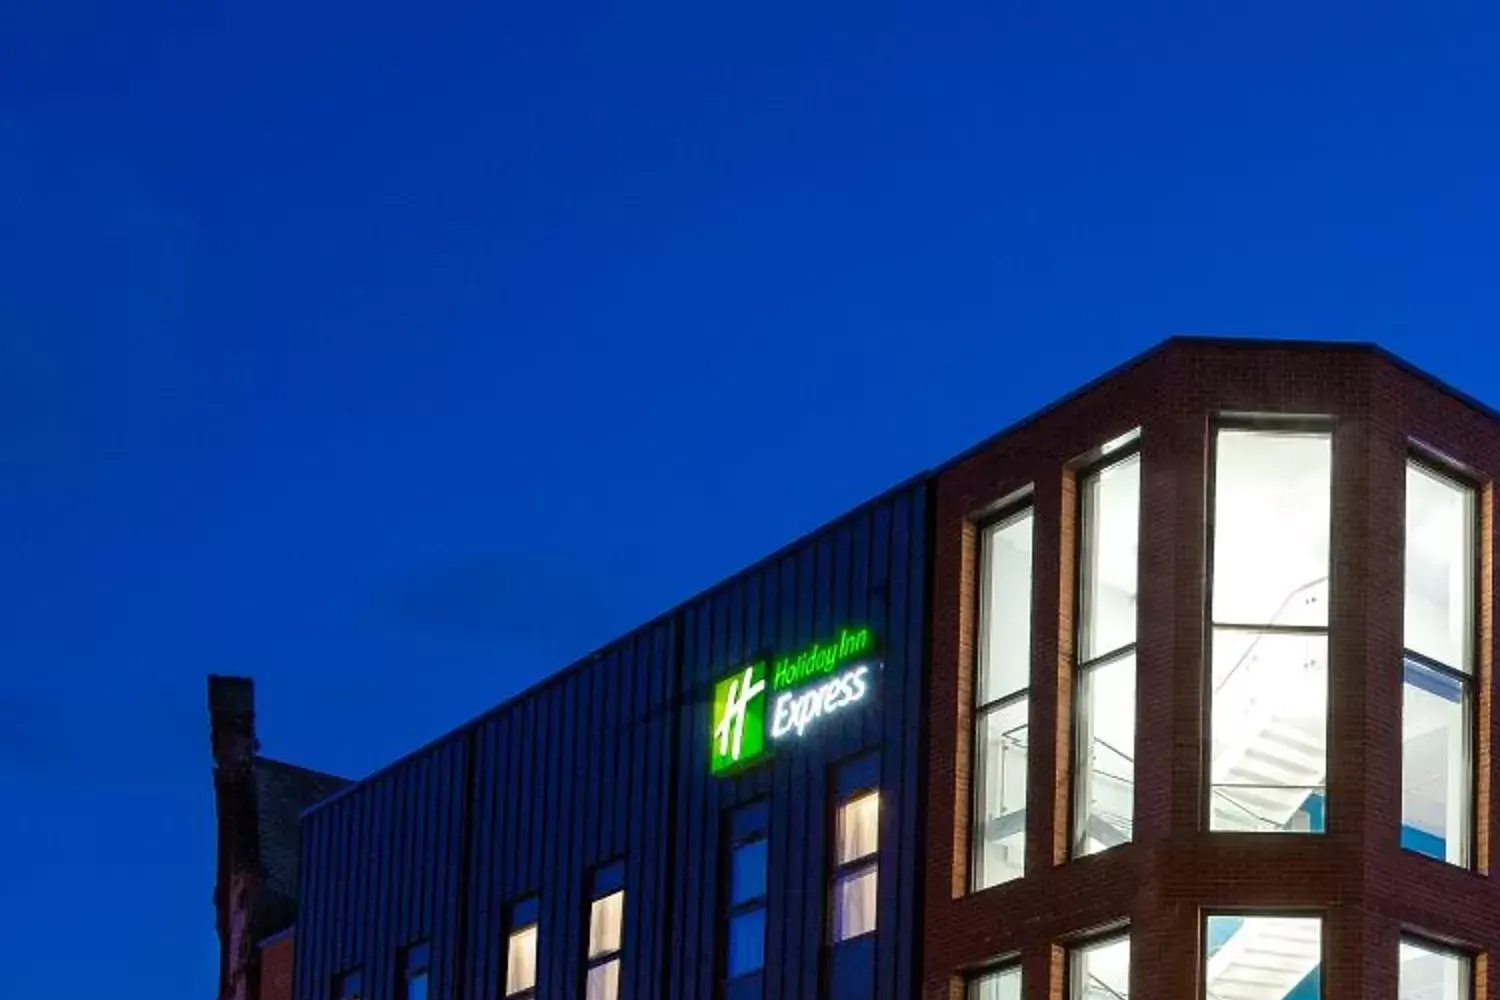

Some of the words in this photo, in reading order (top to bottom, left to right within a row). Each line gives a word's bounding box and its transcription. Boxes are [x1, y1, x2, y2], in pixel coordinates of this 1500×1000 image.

[774, 644, 838, 689] Holiday
[839, 629, 867, 658] Inn
[770, 664, 869, 737] Express
